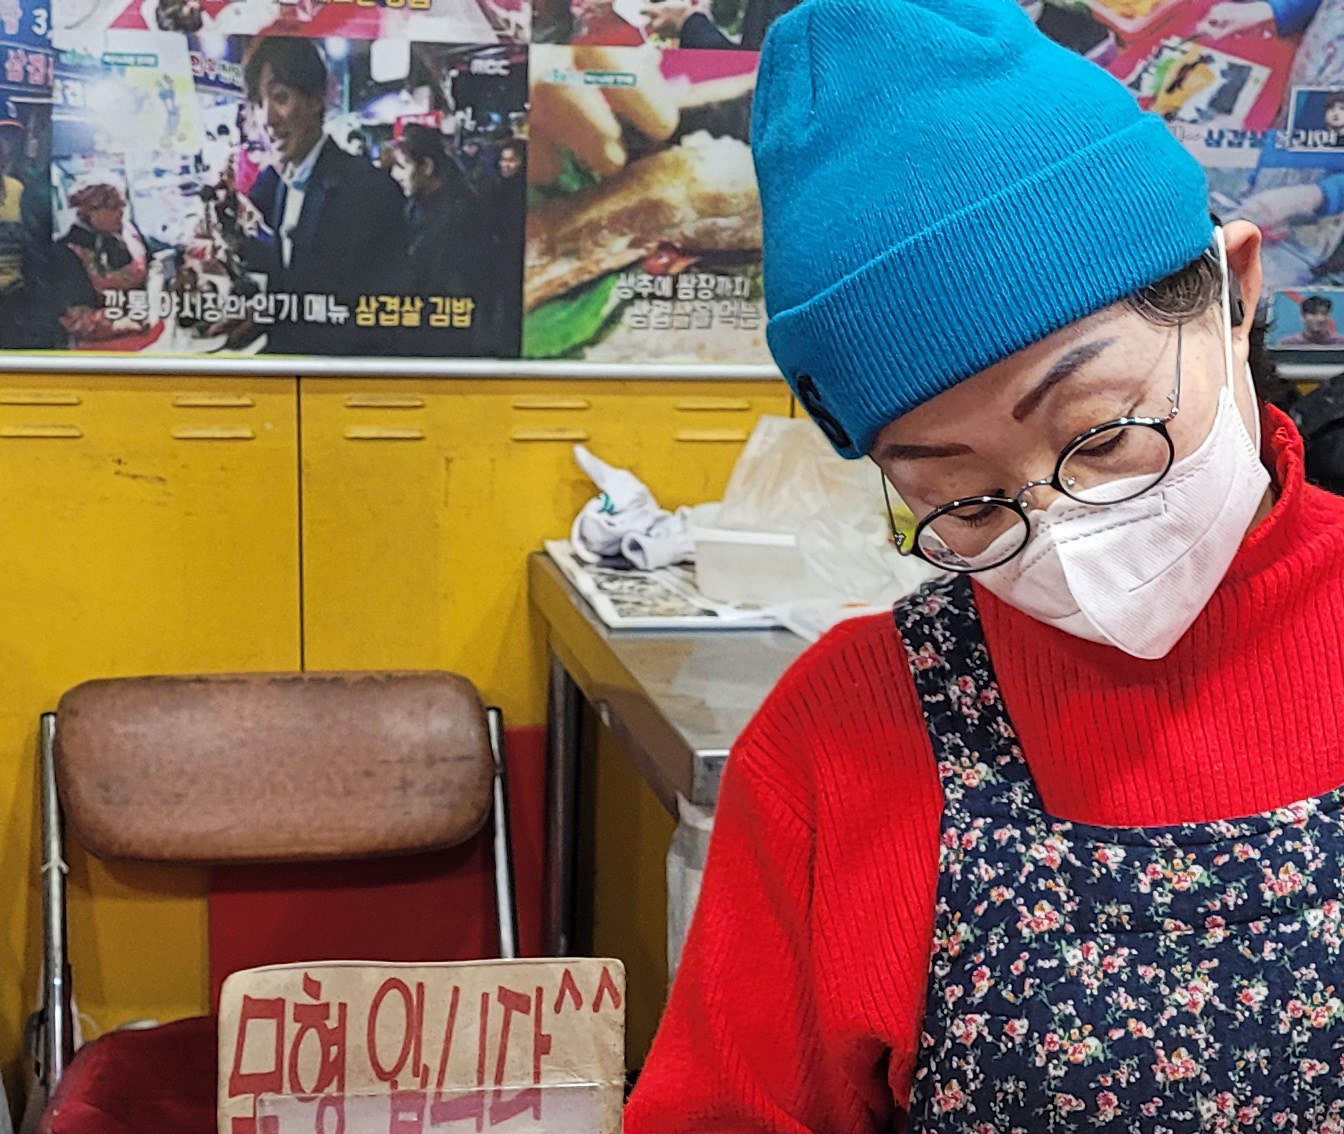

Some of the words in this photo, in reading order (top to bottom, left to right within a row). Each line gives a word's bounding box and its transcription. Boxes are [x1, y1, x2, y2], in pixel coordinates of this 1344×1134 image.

[6, 49, 54, 85] 삼겹
[103, 289, 151, 321] 깡통
[157, 290, 250, 323] 야시장의
[251, 294, 301, 323] 인기
[304, 294, 350, 325] 메뉴
[355, 295, 424, 327] 삼겹살
[429, 297, 475, 328] 김밥
